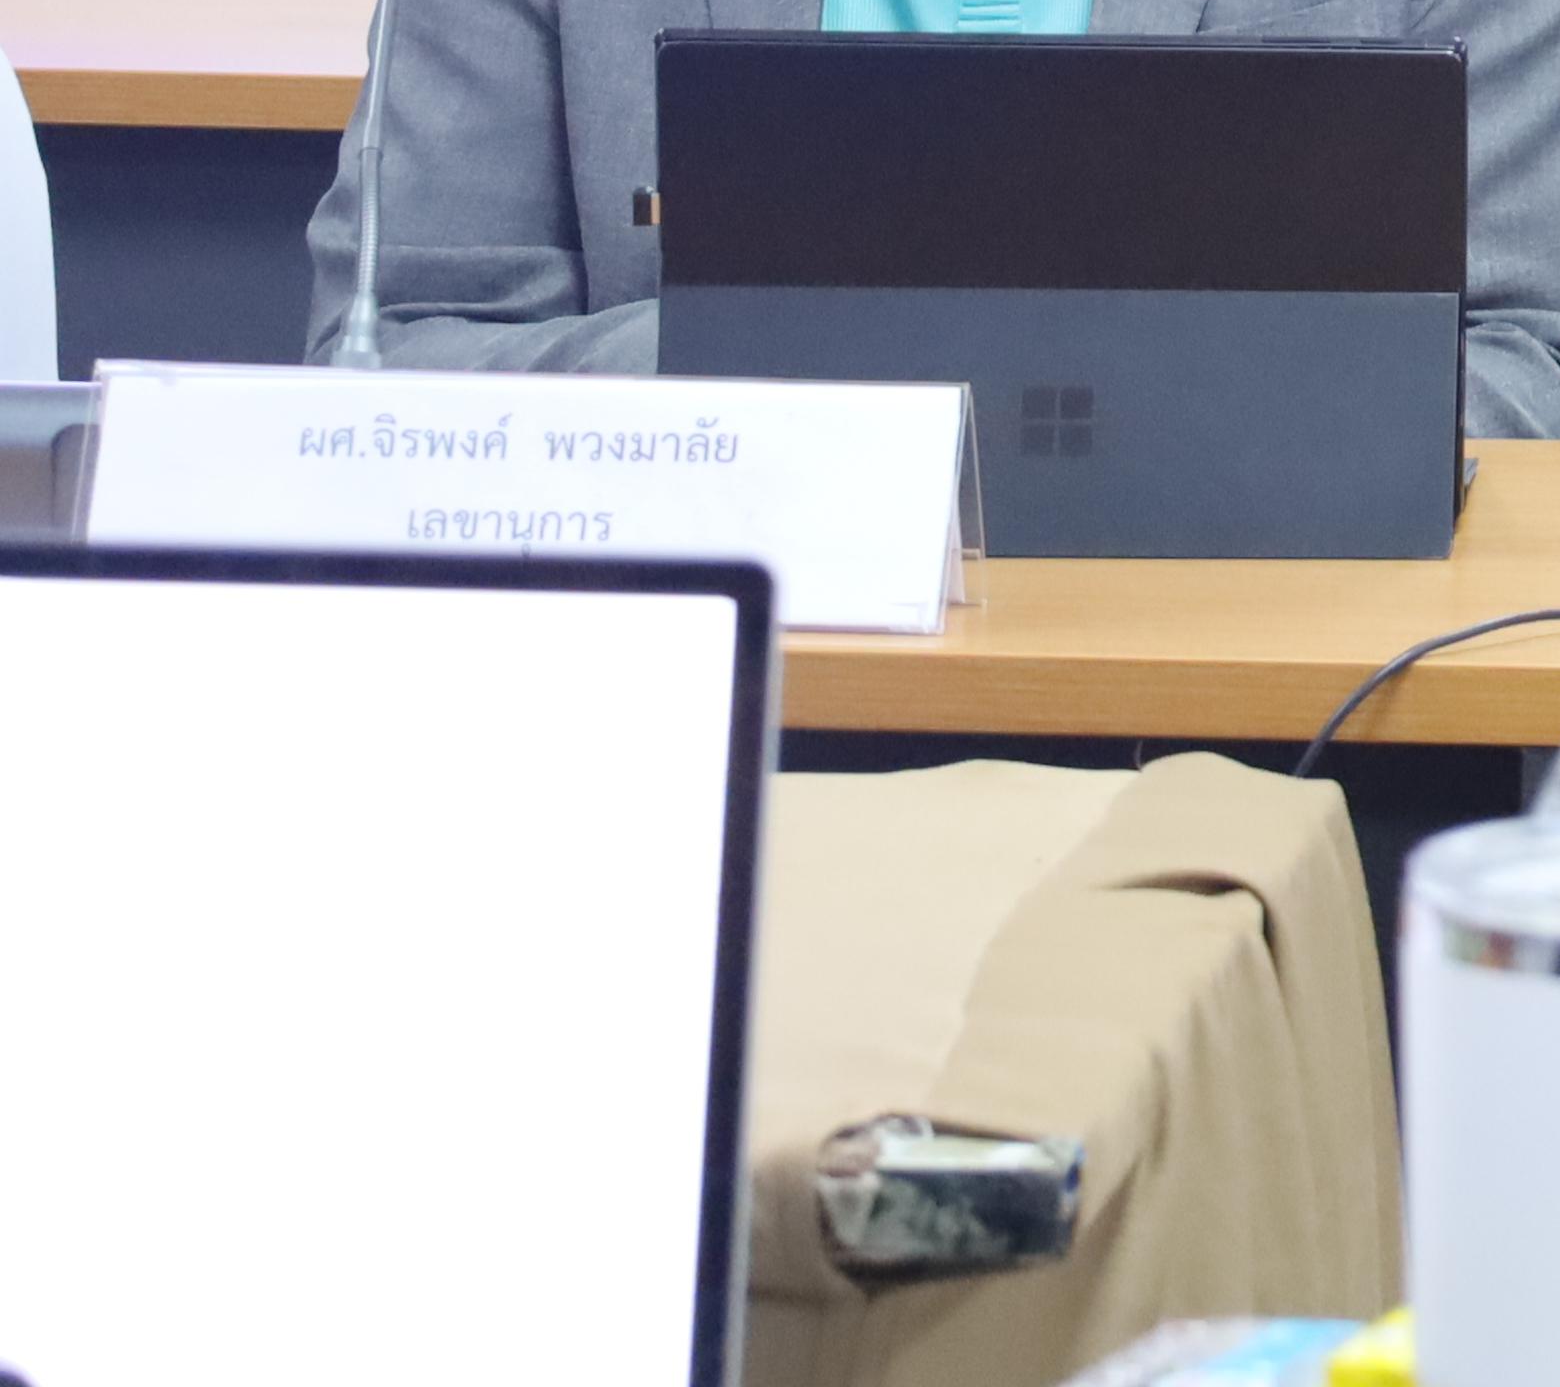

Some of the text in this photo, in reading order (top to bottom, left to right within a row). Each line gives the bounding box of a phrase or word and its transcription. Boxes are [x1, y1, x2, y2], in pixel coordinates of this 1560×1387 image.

[298, 412, 741, 464] ผศ.จิรพงค์ พวงมาลัย
[406, 508, 615, 556] เลขานุการ
